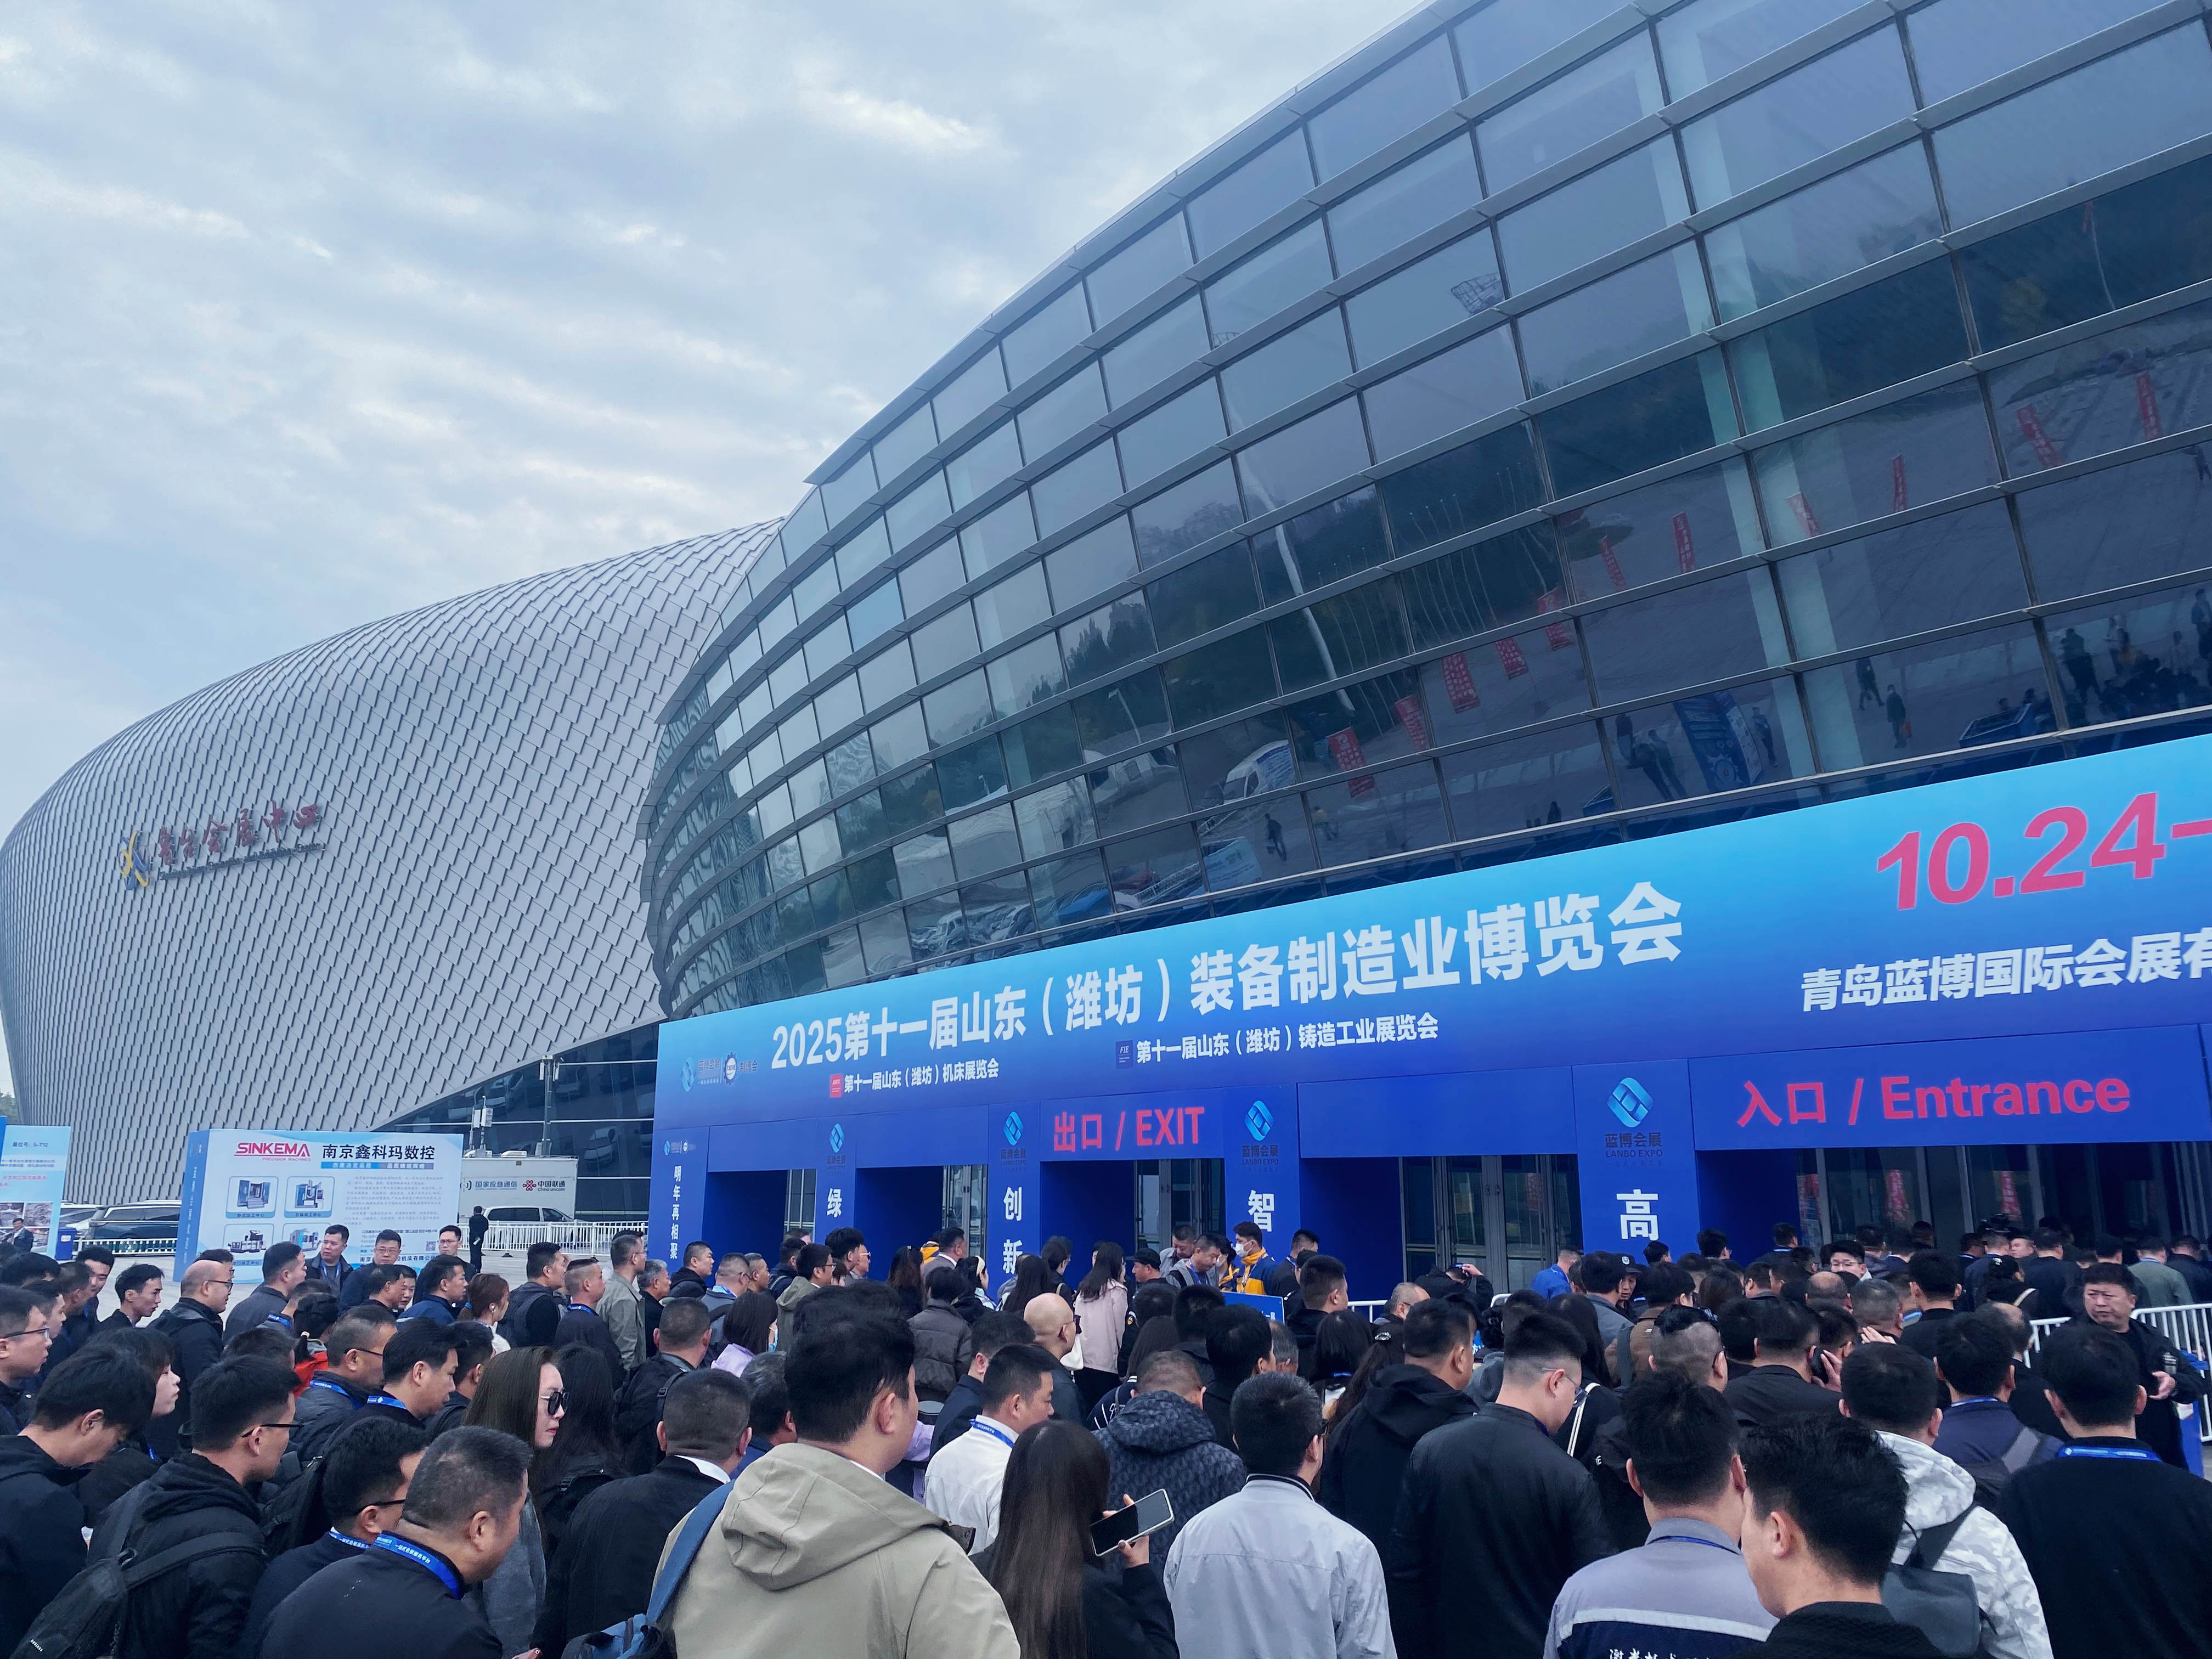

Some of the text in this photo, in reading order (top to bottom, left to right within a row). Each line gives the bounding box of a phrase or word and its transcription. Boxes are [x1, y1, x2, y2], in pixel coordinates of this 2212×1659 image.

[1136, 1012, 1438, 1064] 第十一届山东（潍坊）铸造工业展览会
[844, 1057, 999, 1094] 第十一届山东（潍坊）机床展览会
[1737, 1076, 2130, 1127] 入口 / Entrance
[235, 1142, 311, 1157] SINKEMA
[1054, 1107, 1205, 1153] 出口 / EXIT
[1605, 1132, 1663, 1148] 蓝博会展
[323, 1144, 435, 1160] 南京鑫科玛数控
[1242, 1144, 1279, 1157] 蓝博会展
[1606, 1149, 1636, 1158] LANBO
[670, 1165, 682, 1260] 明年再相聚
[827, 1188, 842, 1218] 绿
[1248, 1189, 1274, 1232] 智
[1616, 1189, 1659, 1241] 高
[1003, 1186, 1023, 1274] 创新
